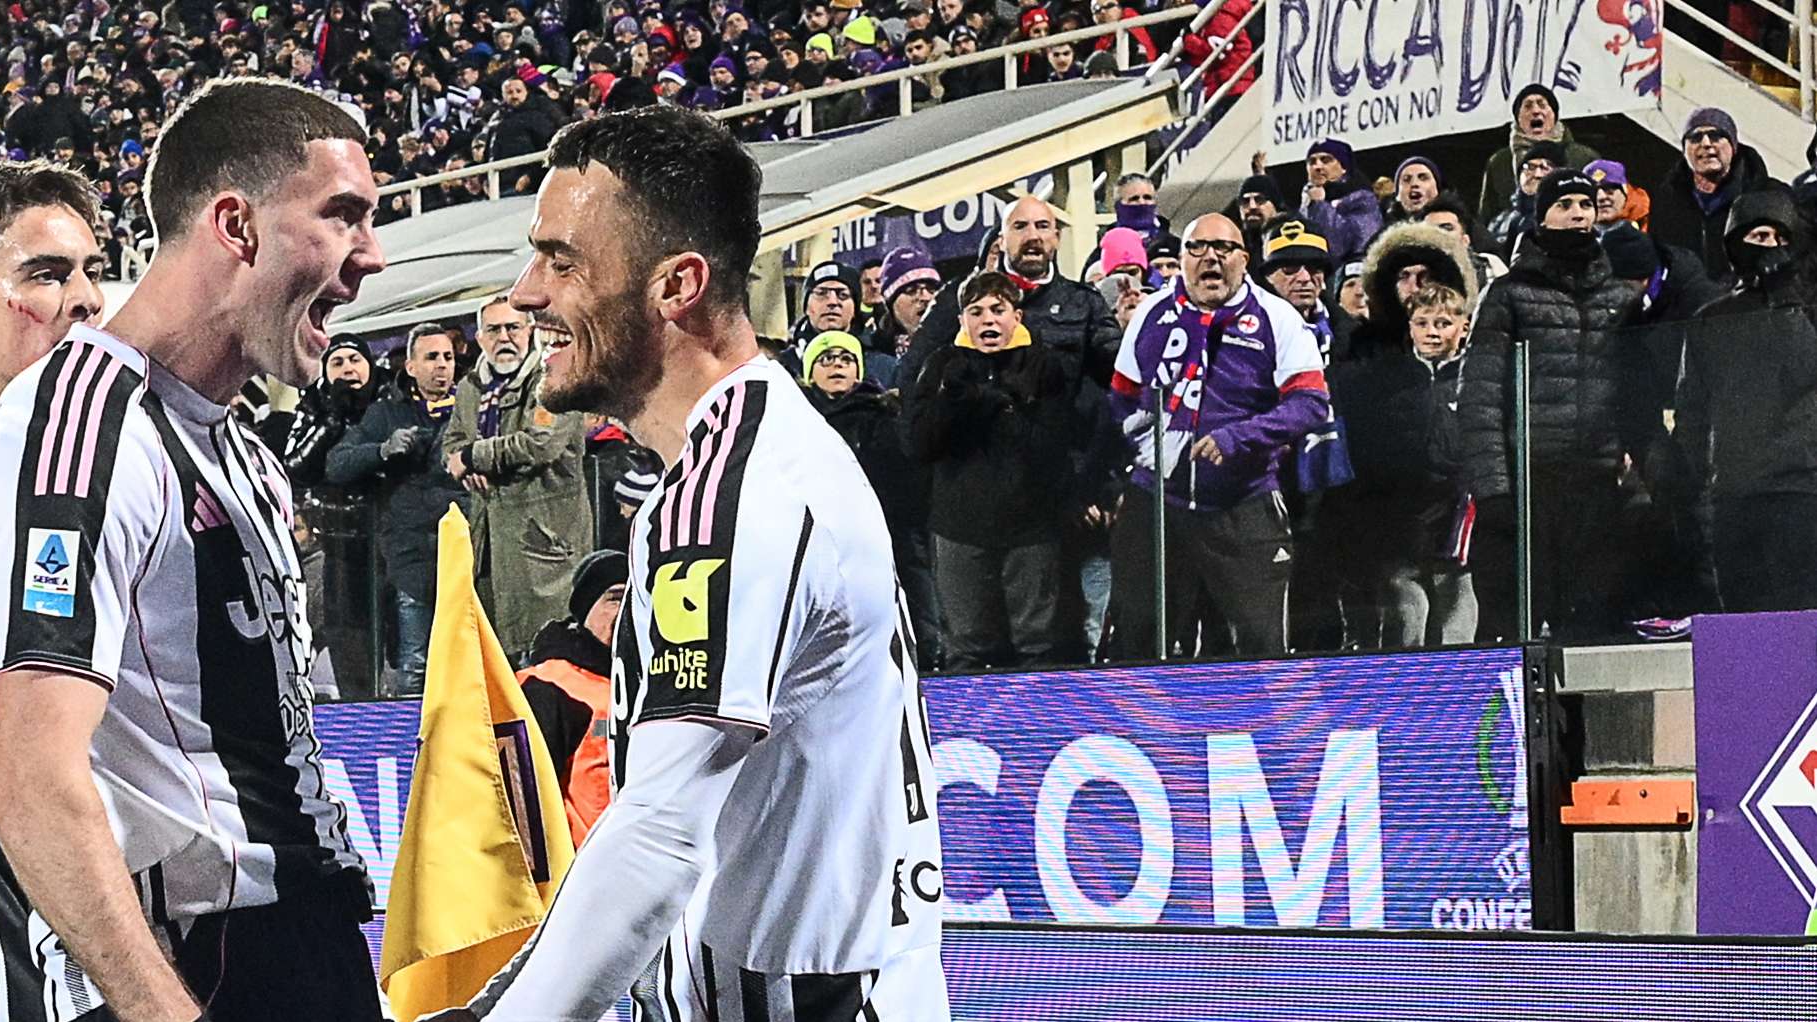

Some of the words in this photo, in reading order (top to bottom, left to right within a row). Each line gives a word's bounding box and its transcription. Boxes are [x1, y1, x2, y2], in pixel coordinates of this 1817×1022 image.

[1273, 103, 1350, 146] SEMPRE
[1357, 95, 1400, 132] CON
[1409, 84, 1443, 121] NOI
[649, 647, 708, 676] white
